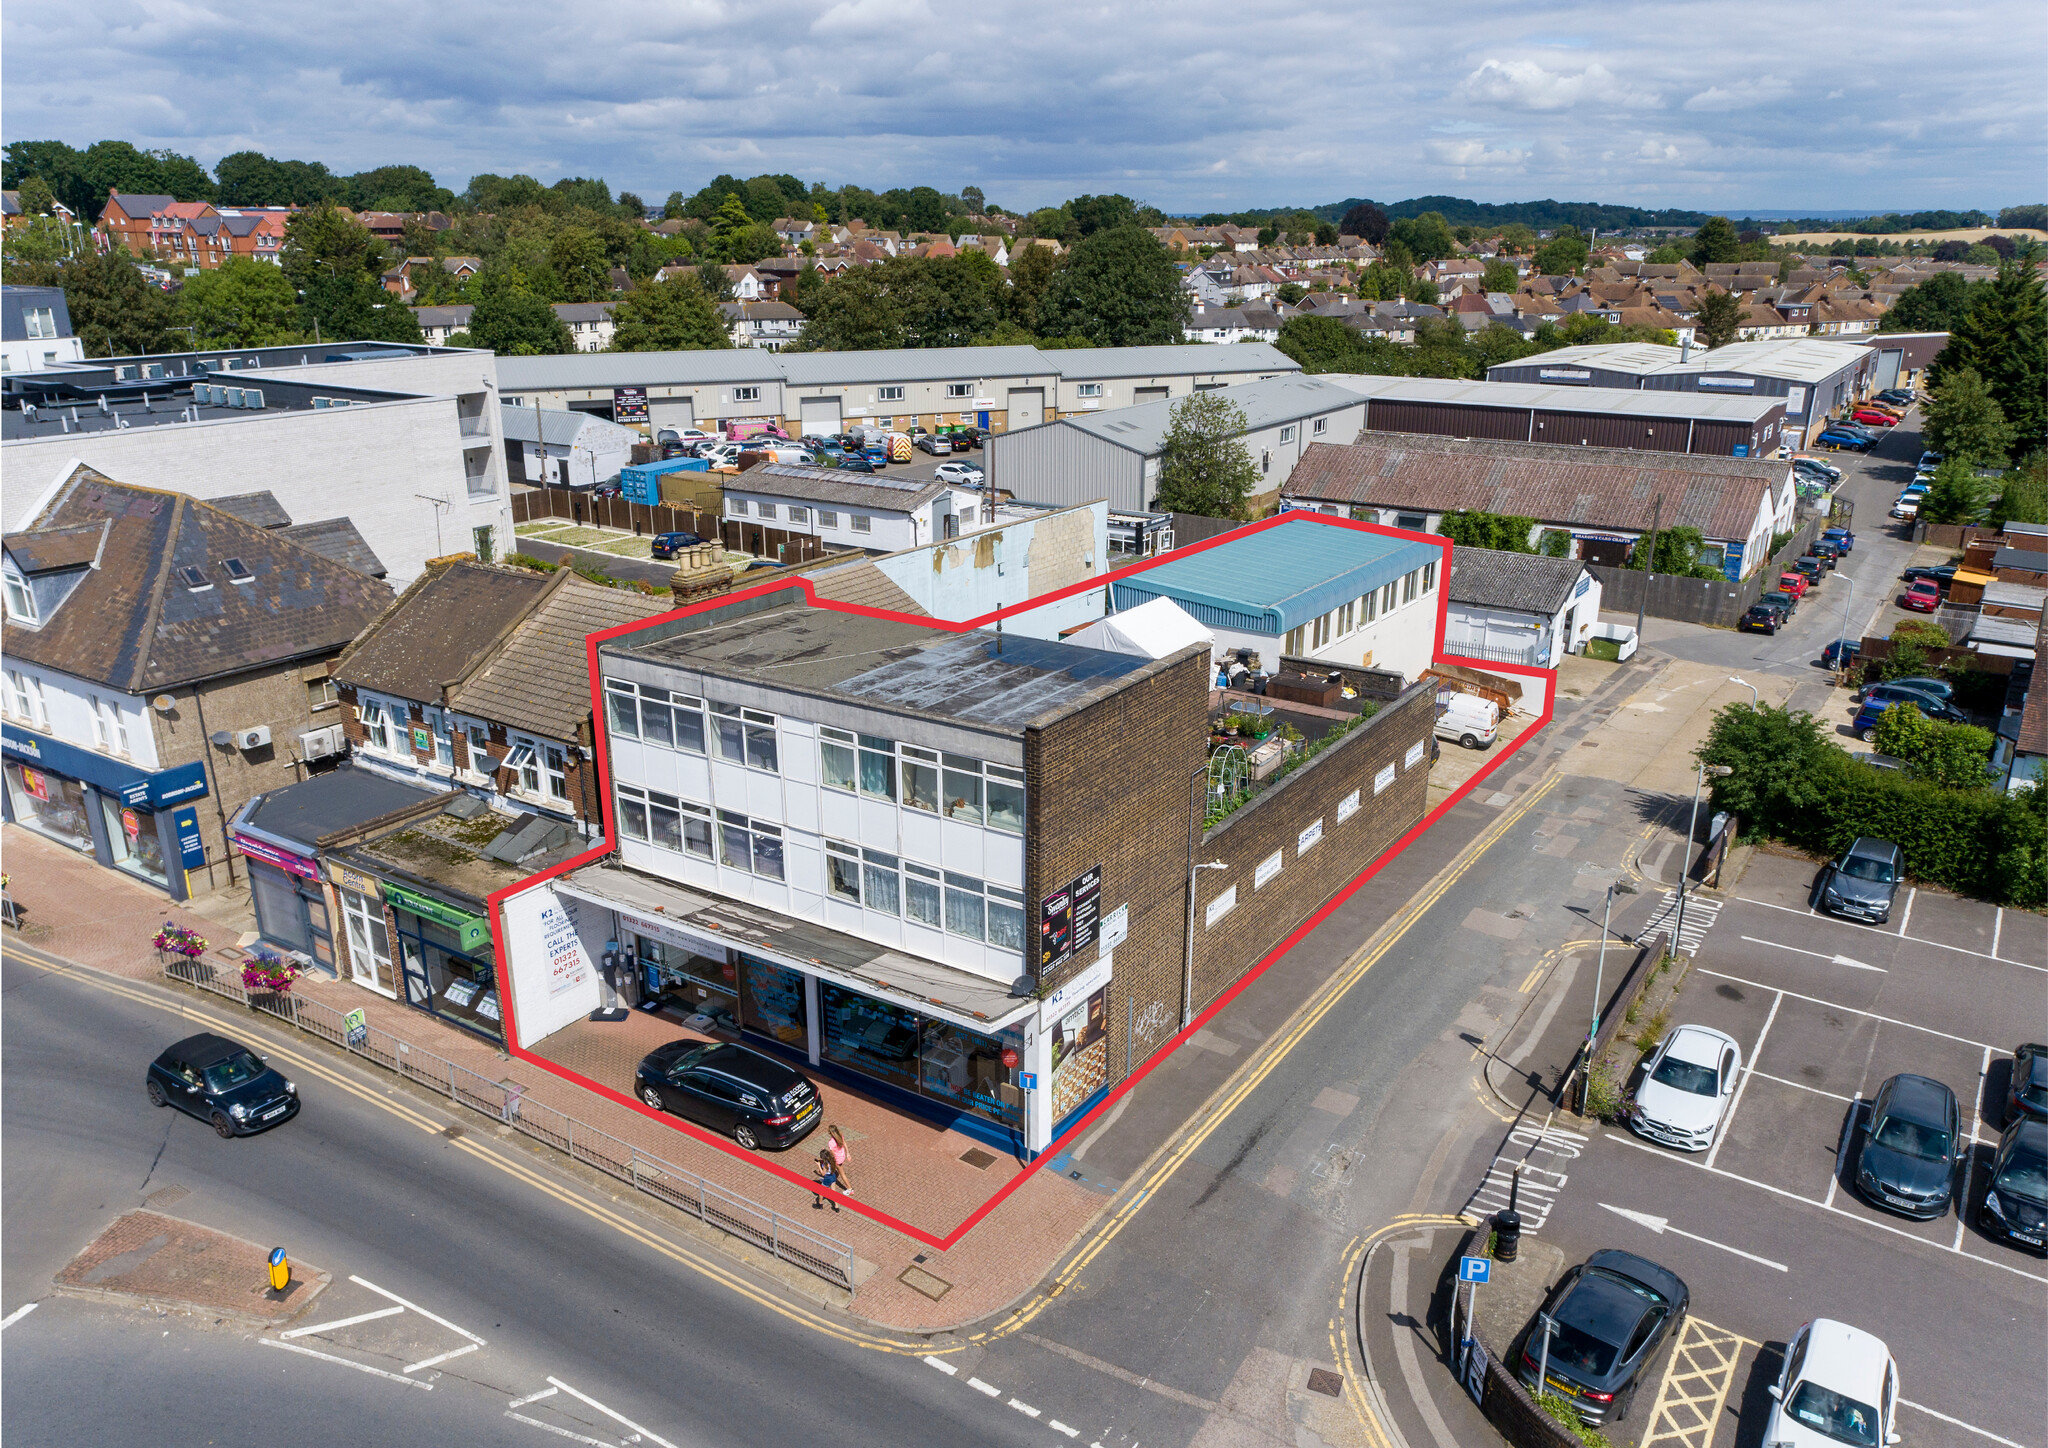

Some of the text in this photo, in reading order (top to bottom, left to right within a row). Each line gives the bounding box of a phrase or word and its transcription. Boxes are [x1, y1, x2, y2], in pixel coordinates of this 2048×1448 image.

[1575, 533, 1598, 541] SHARON'S
[1405, 749, 1422, 765] LOORING
[1375, 770, 1394, 788] LOORING
[129, 790, 146, 799] ESTATE
[130, 795, 148, 804] AGENTS
[343, 868, 364, 883] Acorn
[1082, 873, 1093, 884] OUR
[342, 876, 366, 892] Centre
[1076, 877, 1100, 897] SERVICES
[541, 909, 553, 920] K2
[565, 907, 578, 915] YOUR
[1104, 907, 1125, 925] CARRICK
[549, 916, 573, 930] FLOORING
[622, 915, 638, 925] 01322
[640, 921, 660, 932] 667315
[547, 929, 579, 948] CALL THE
[550, 939, 578, 958] EXPERTS
[554, 950, 577, 965] 01322
[553, 958, 580, 976] 667315
[1052, 990, 1063, 1006] K2
[1065, 1006, 1085, 1025] amtico
[950, 1083, 962, 1091] NOT
[964, 1088, 971, 1096] BE
[972, 1091, 996, 1105] BEATEN
[996, 1099, 1005, 1109] ON
[962, 1096, 974, 1106] OUR
[974, 1101, 992, 1113] PRICE
[1508, 1120, 1589, 1158] NO
[1467, 1260, 1486, 1279] P
